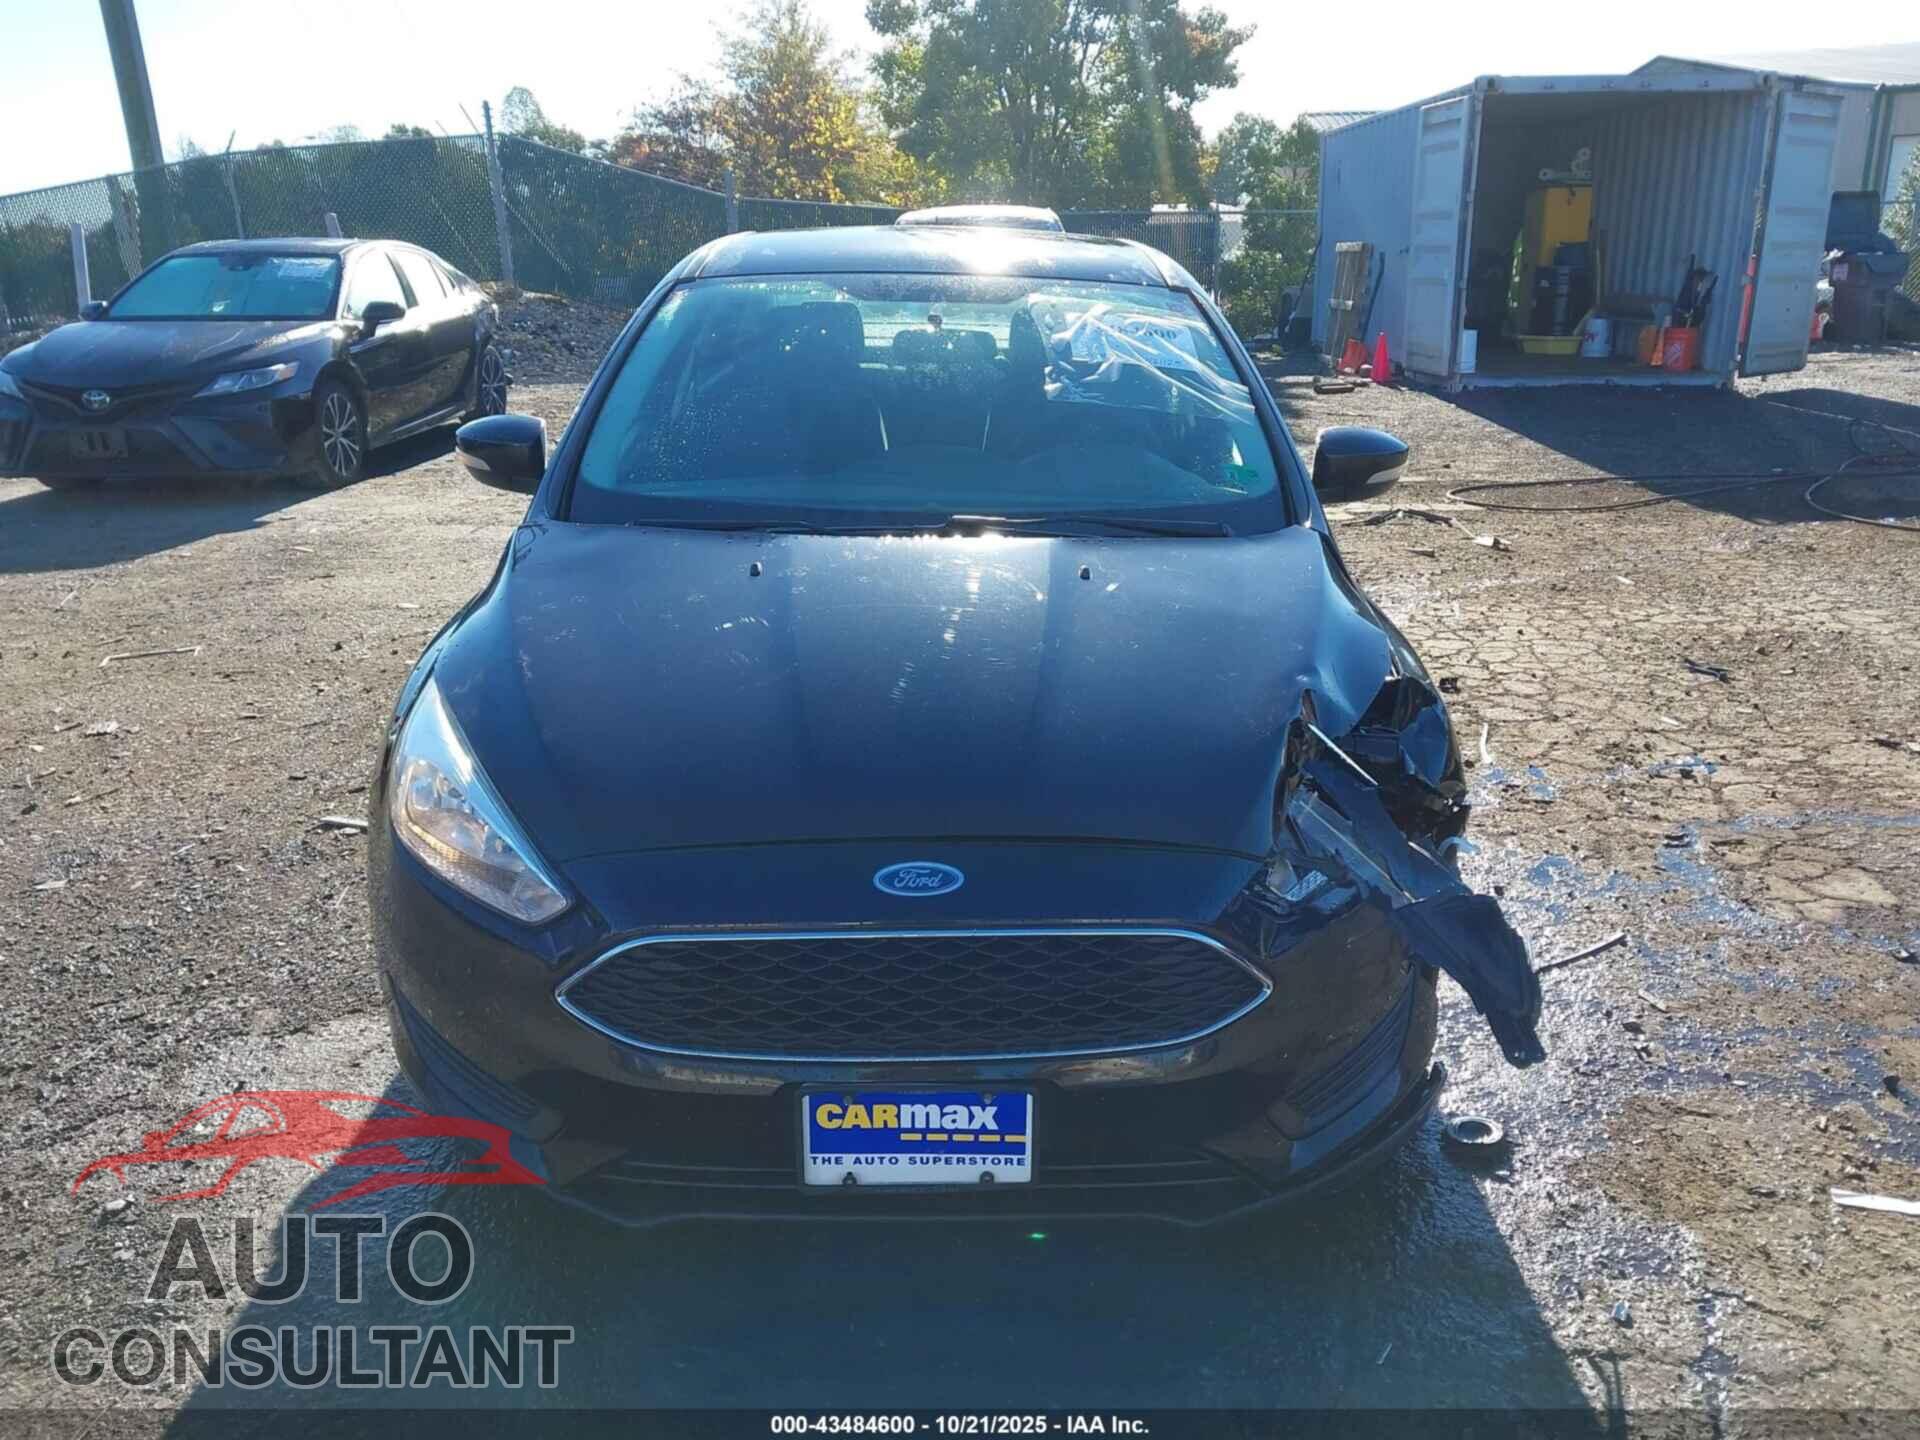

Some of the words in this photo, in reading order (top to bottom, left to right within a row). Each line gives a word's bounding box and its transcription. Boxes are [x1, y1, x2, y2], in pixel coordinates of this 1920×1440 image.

[894, 868, 944, 888] Ford
[815, 1103, 999, 1130] CARmax
[810, 1156, 844, 1165] THE
[852, 1156, 900, 1165] AUTO
[907, 1156, 1026, 1167] SUPERSTORE
